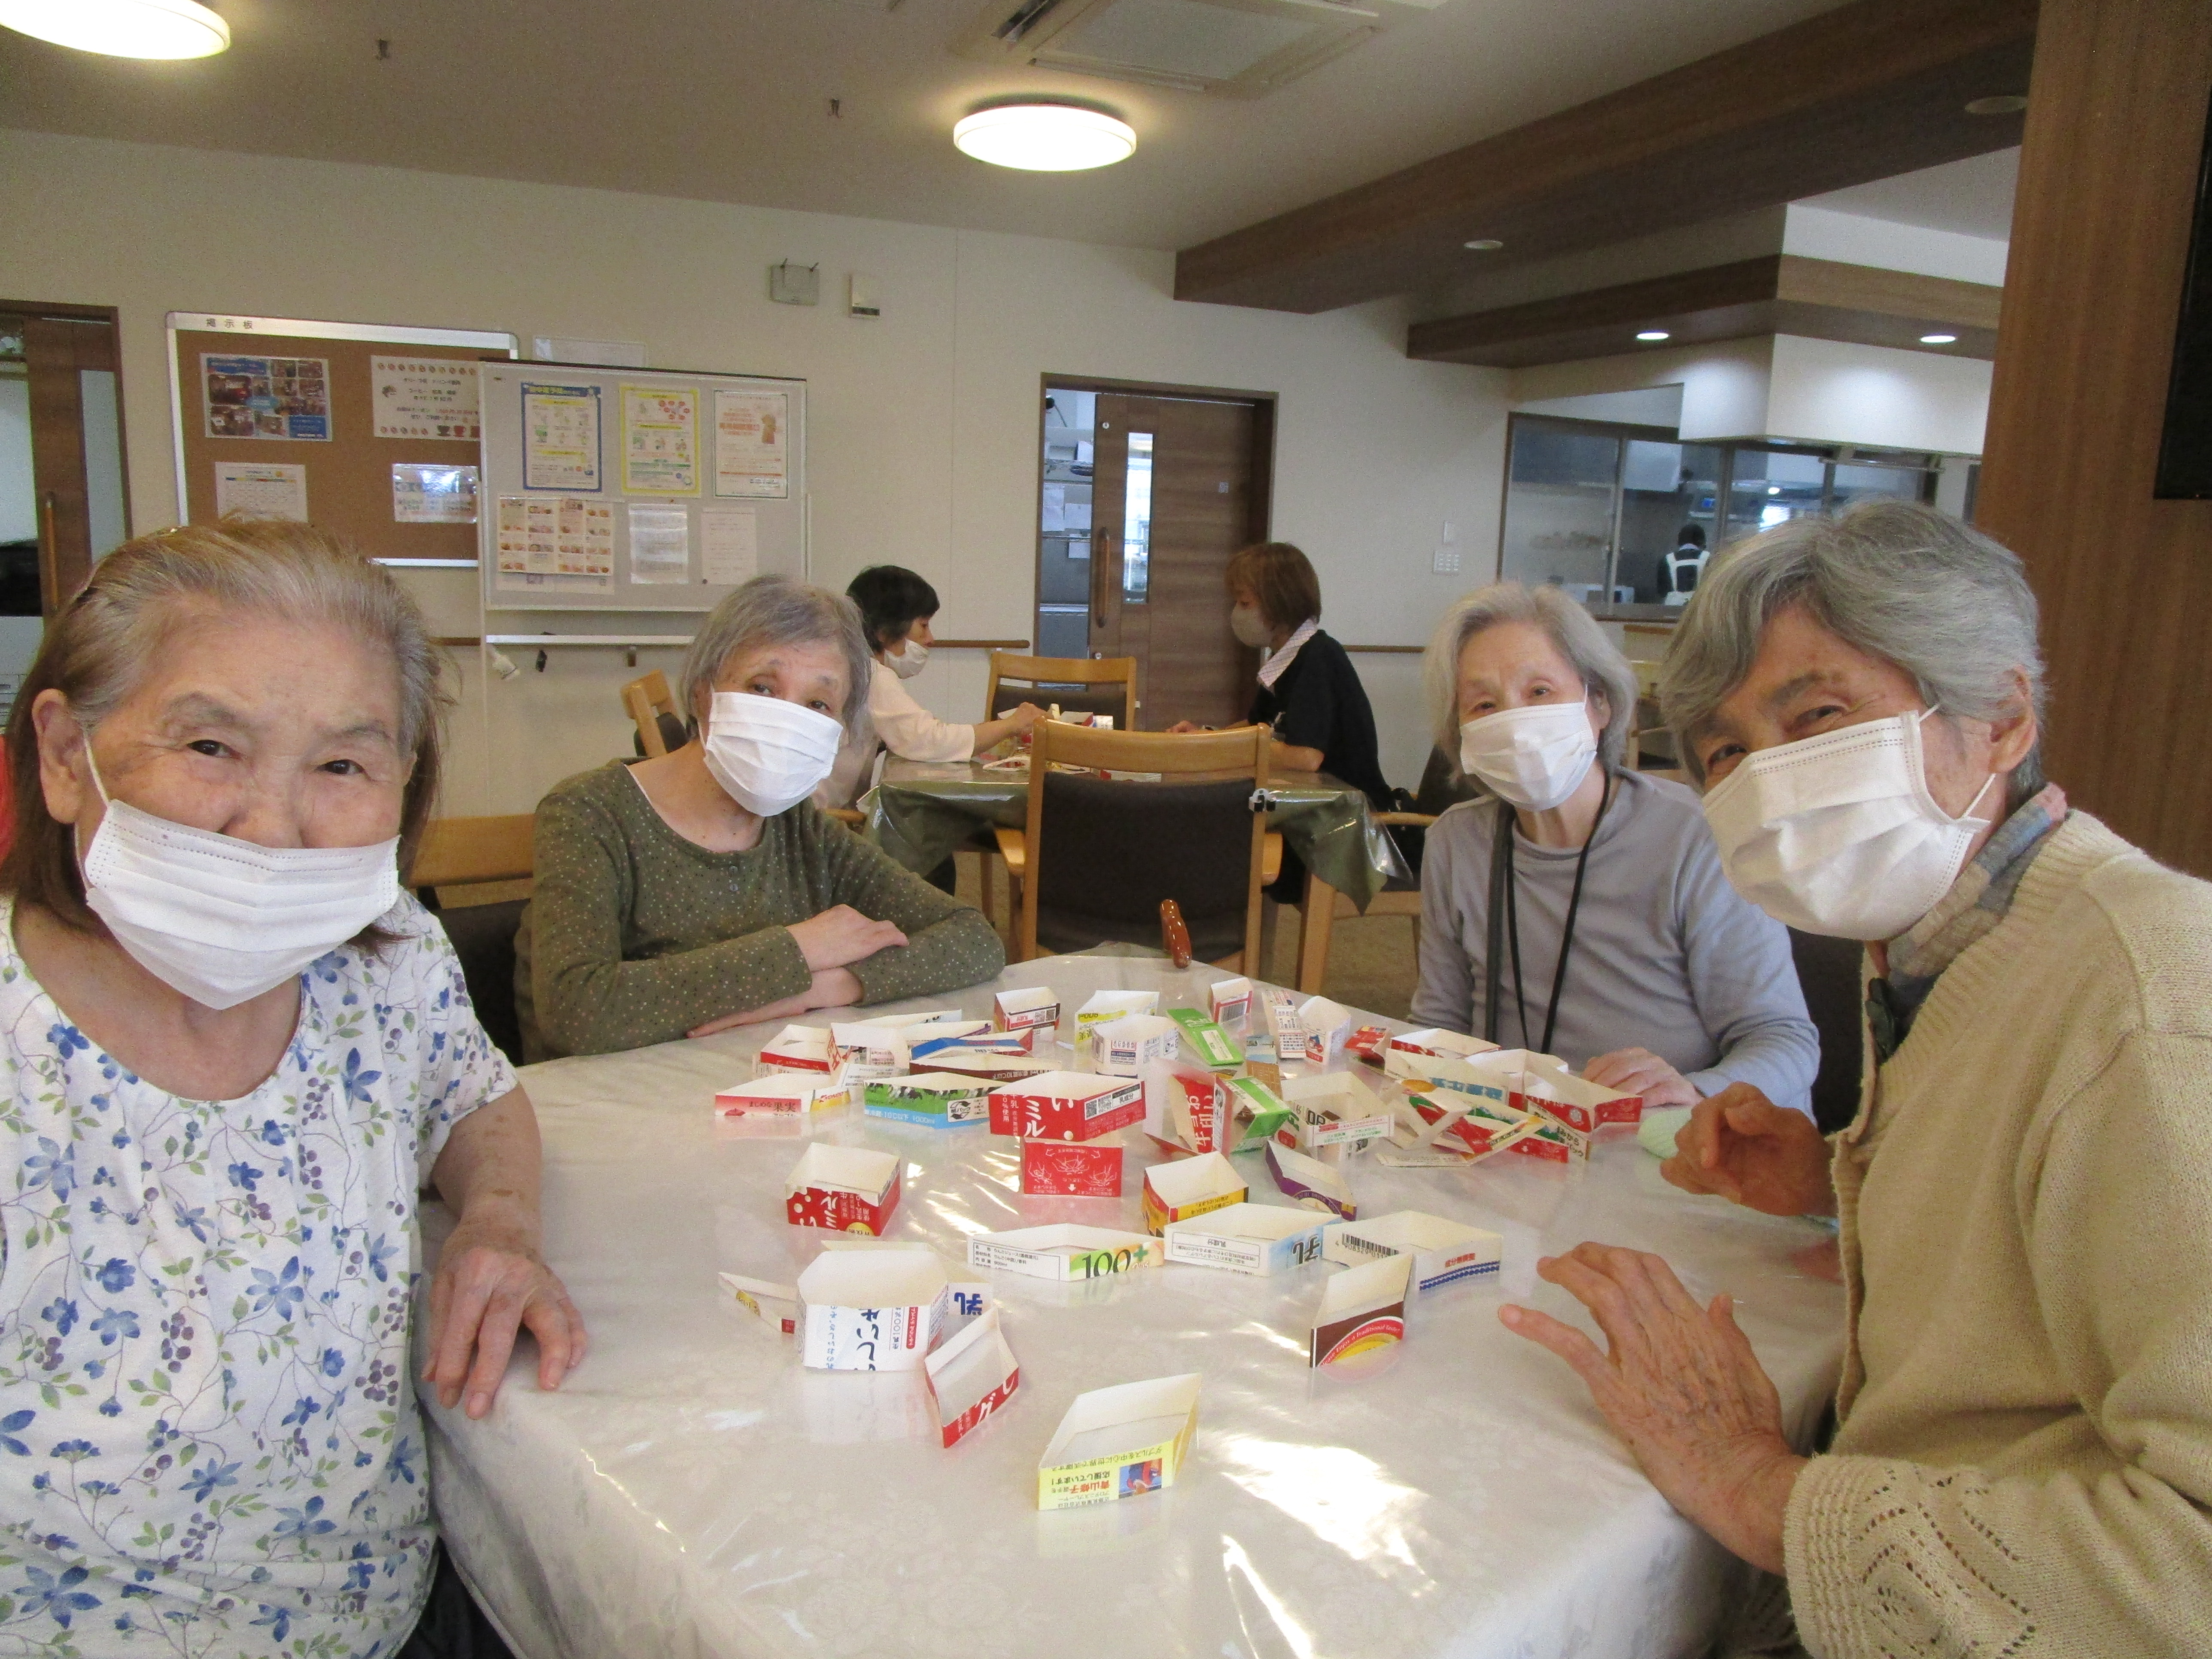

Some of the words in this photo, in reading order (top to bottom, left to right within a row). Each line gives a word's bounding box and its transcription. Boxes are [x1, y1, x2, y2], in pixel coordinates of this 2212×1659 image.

[748, 1101, 796, 1112] まじめな果実
[1022, 1095, 1046, 1137] ミル
[820, 1190, 839, 1228] ミル
[1207, 1239, 1226, 1247] 乳成分
[1082, 1249, 1131, 1279] 100
[1356, 1324, 1386, 1337] Traditional
